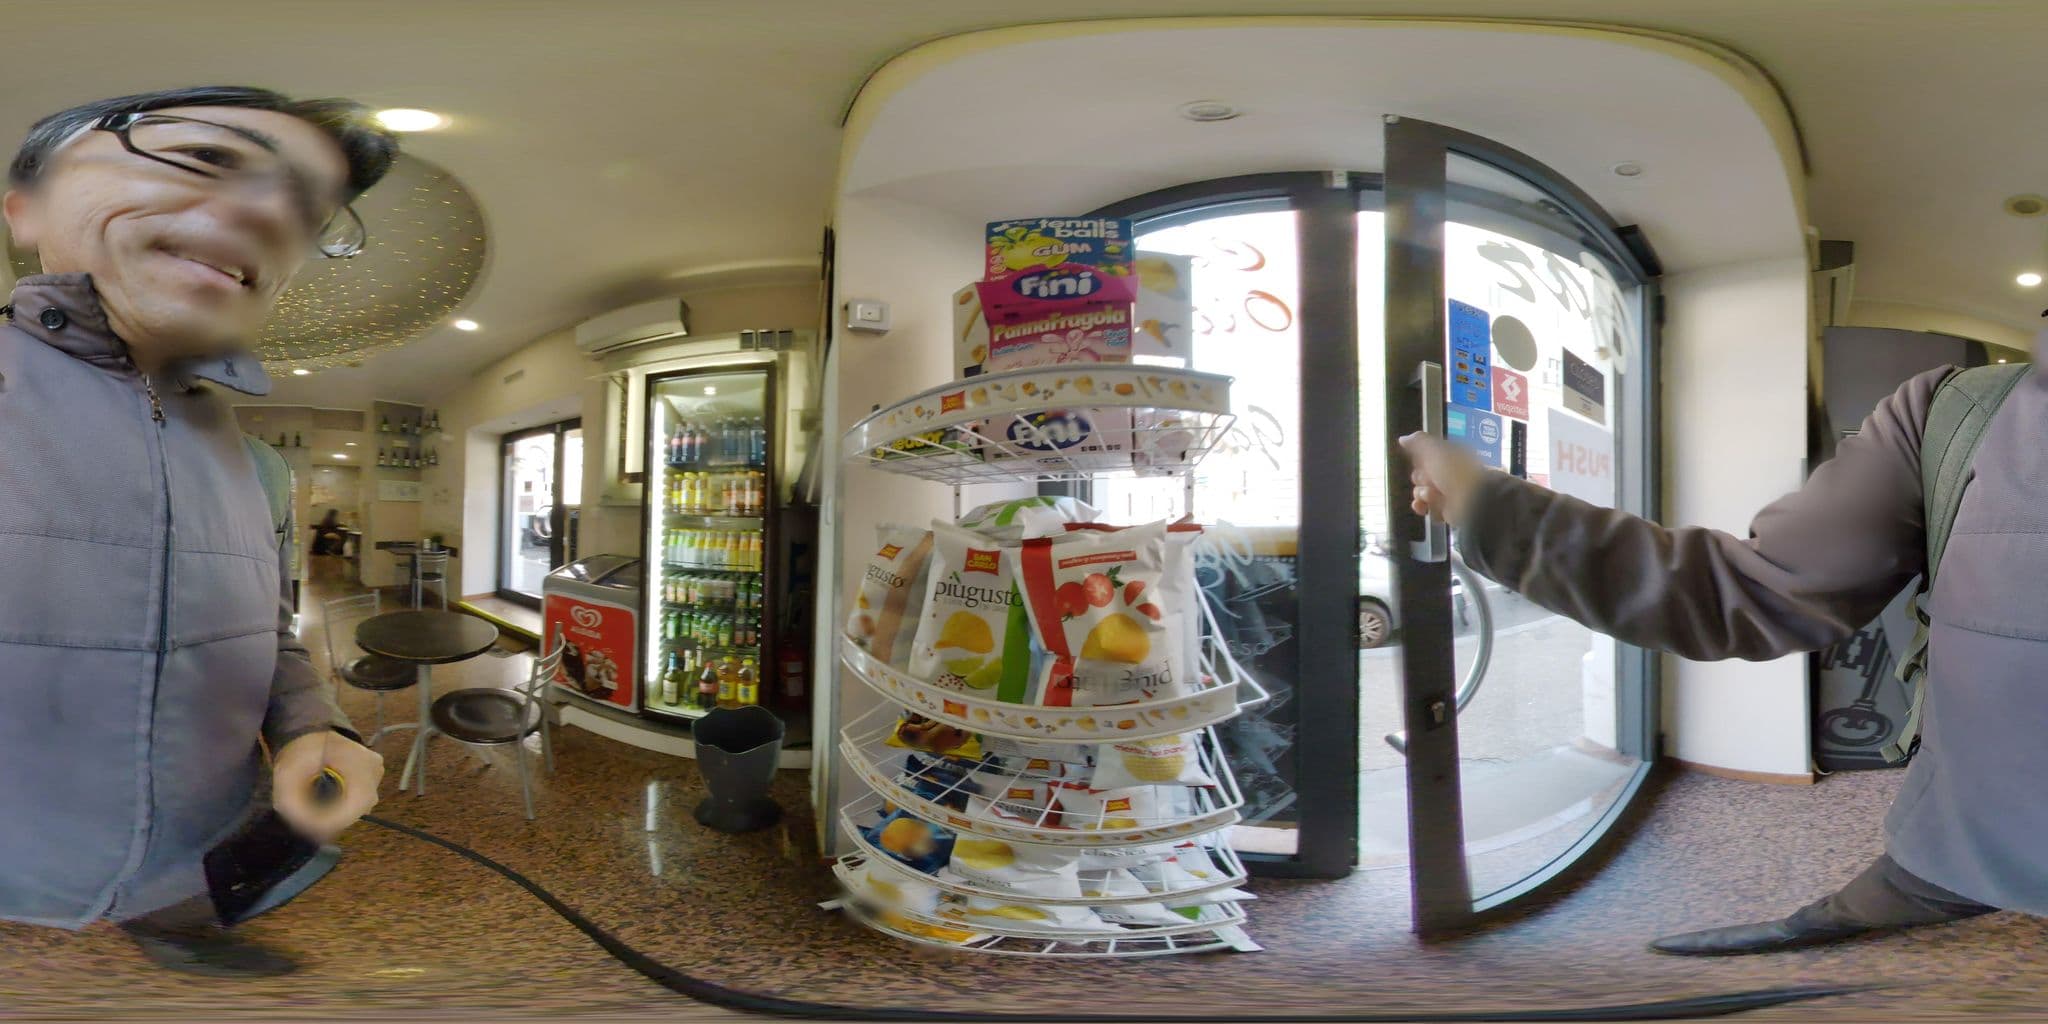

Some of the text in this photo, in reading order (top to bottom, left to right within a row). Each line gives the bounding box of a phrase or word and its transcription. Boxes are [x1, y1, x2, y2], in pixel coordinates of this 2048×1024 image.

[1039, 218, 1120, 229] tennis
[1055, 226, 1120, 238] balls
[1020, 271, 1093, 298] Fini
[1013, 411, 1086, 447] Fini
[933, 571, 1025, 608] piùgusto
